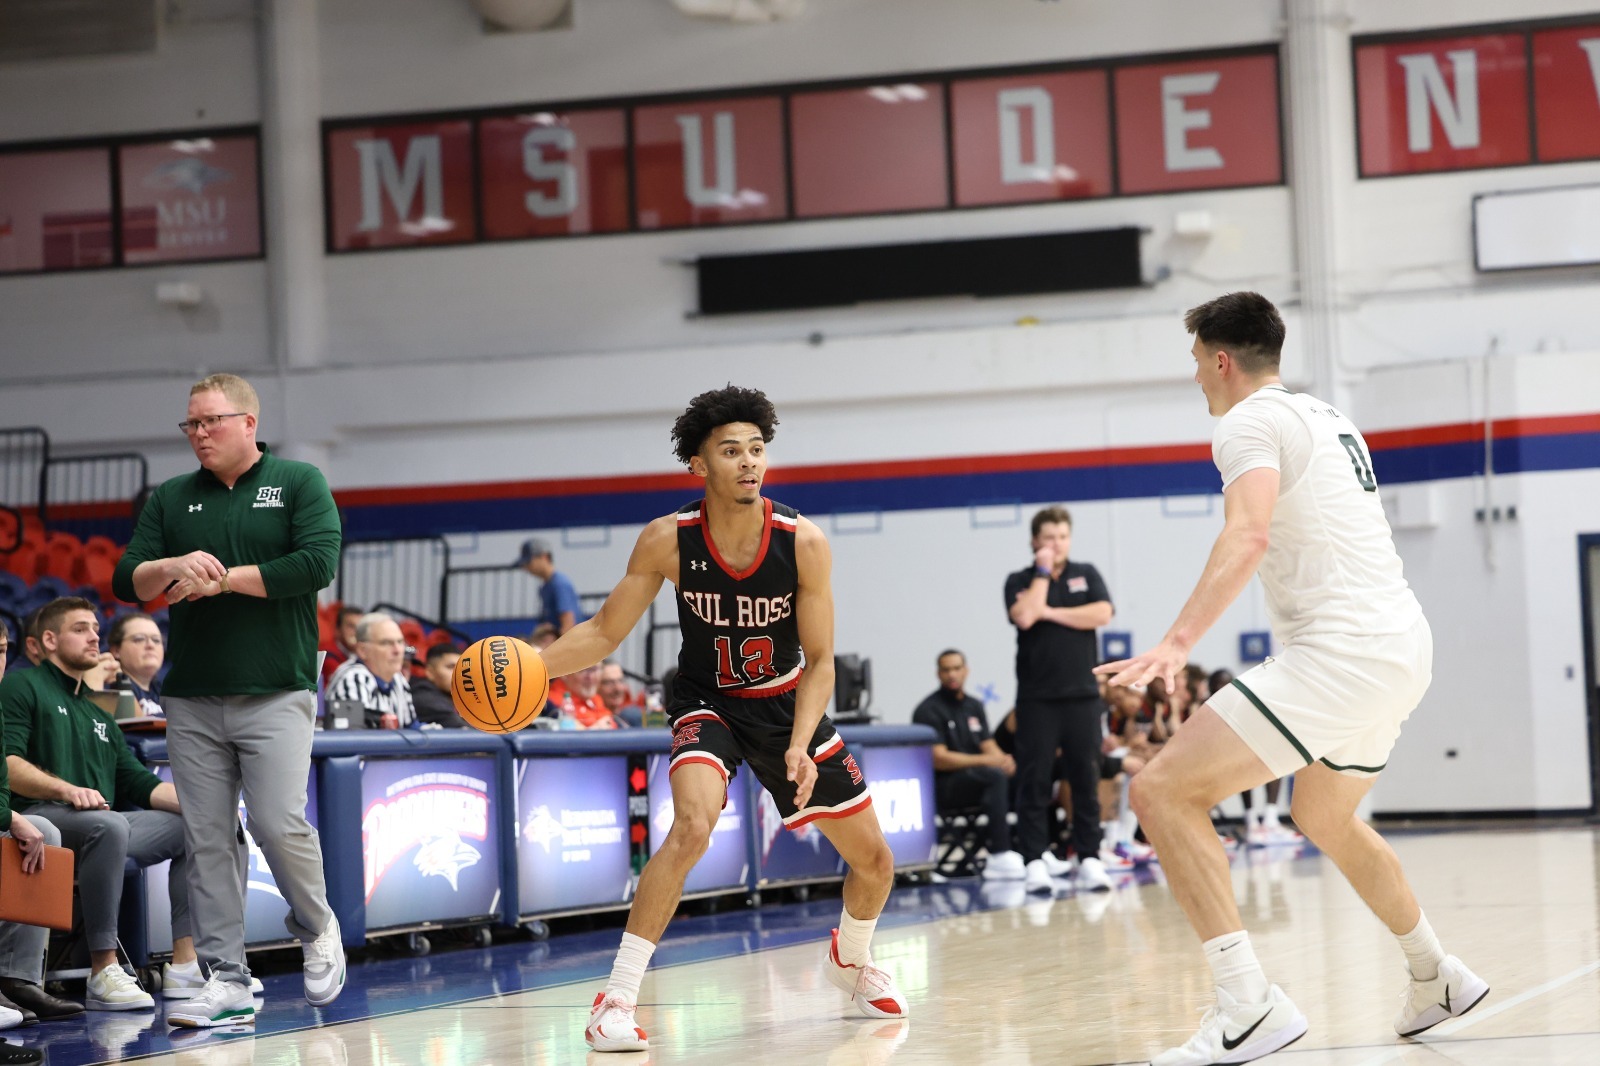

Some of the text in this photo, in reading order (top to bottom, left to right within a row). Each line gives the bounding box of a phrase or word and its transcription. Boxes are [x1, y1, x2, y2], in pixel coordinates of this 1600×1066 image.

[1338, 433, 1376, 492] 0
[256, 486, 282, 503] BH
[683, 591, 793, 627] SUL ROSS
[461, 657, 476, 692] EVO
[489, 640, 510, 699] Wilson
[714, 635, 780, 688] 12
